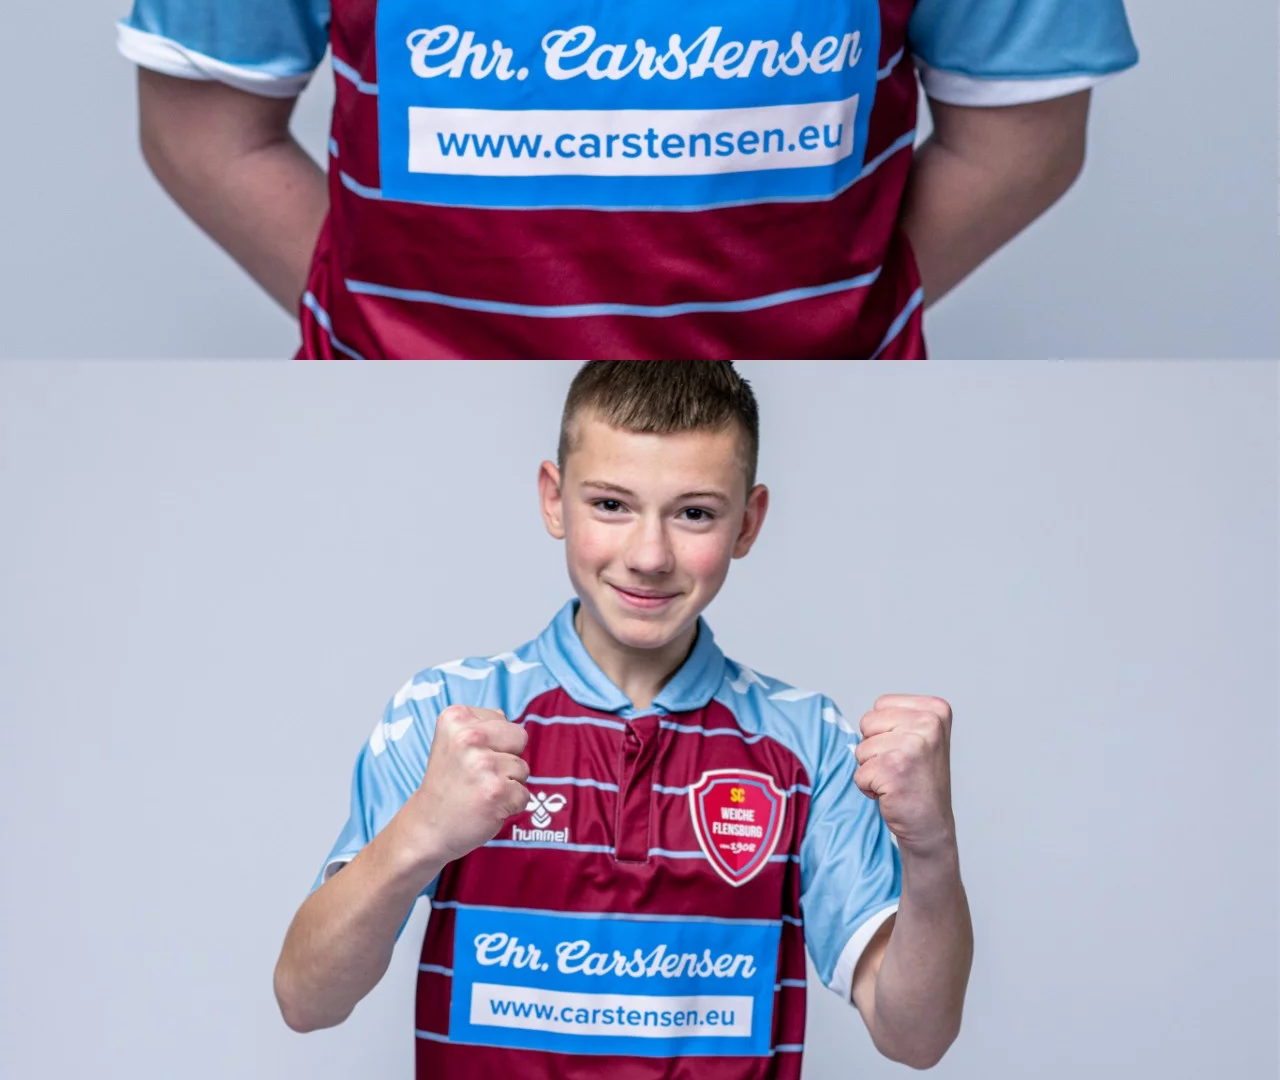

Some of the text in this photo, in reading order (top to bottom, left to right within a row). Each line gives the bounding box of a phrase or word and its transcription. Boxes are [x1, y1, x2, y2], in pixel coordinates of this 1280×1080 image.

[405, 24, 862, 81] Chr. Carstensen
[436, 123, 843, 160] www.carstensen.eu
[730, 787, 745, 803] SC
[721, 807, 755, 822] WEICHE
[512, 824, 568, 843] hummel
[712, 821, 763, 838] FLENSBURG
[474, 932, 757, 979] Chr. Carstensen
[489, 998, 735, 1027] www.carstensen.eu
